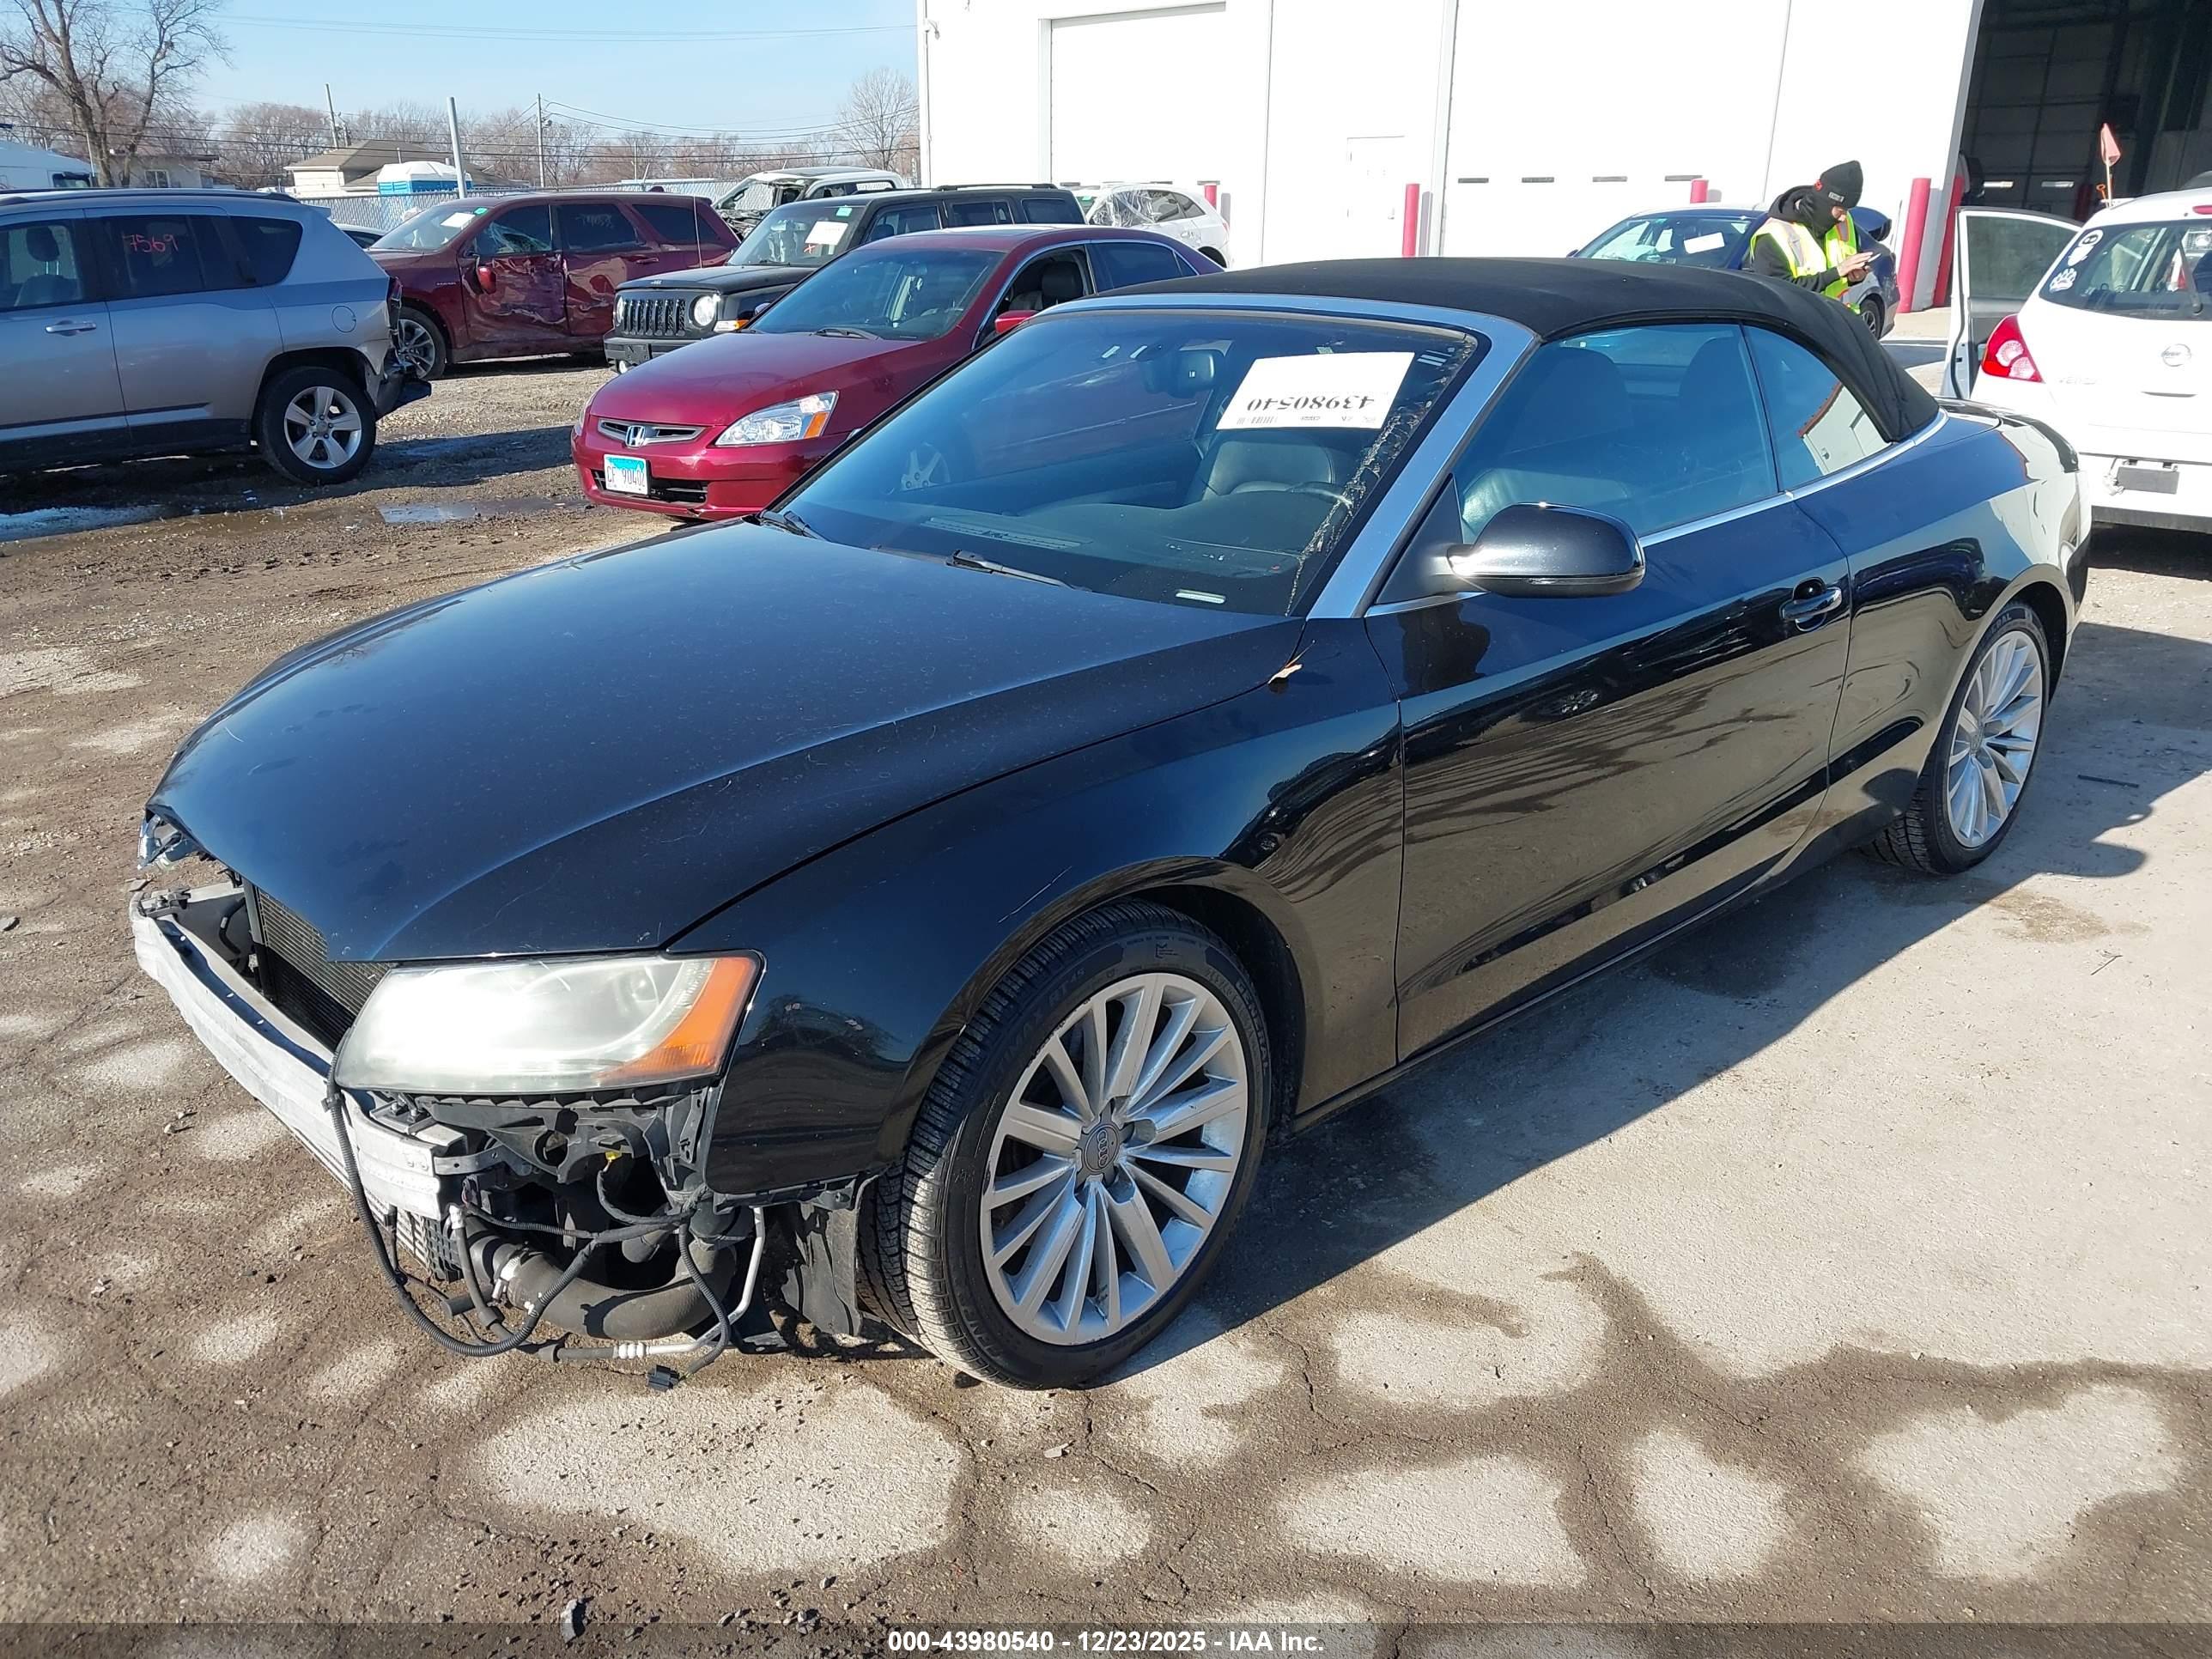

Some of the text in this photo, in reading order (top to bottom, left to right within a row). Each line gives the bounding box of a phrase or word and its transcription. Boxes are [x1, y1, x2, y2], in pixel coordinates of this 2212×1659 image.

[121, 234, 179, 252] 7569
[1247, 396, 1375, 411] 43980540
[1234, 977, 1270, 1076] GENERAL
